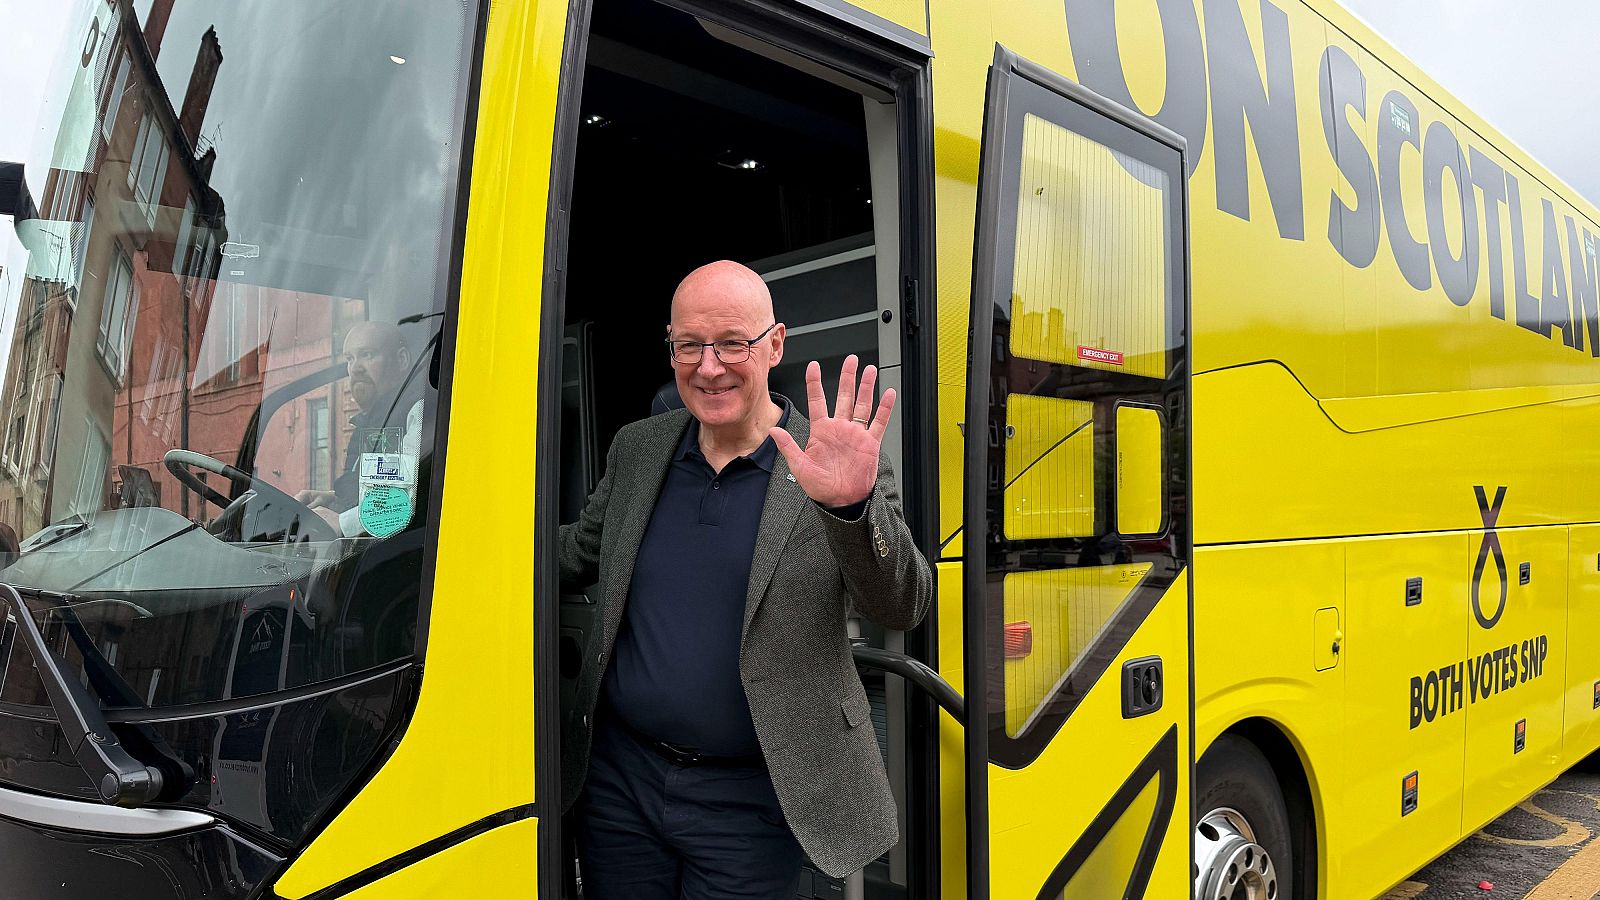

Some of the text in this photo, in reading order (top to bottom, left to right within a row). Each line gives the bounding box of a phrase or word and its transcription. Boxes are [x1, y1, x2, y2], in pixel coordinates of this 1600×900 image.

[1064, 0, 1600, 358] ON SCOTLAN
[1082, 349, 1119, 361] EMERGENCY EXIT
[1410, 634, 1548, 730] BOTH VOTES SNP
